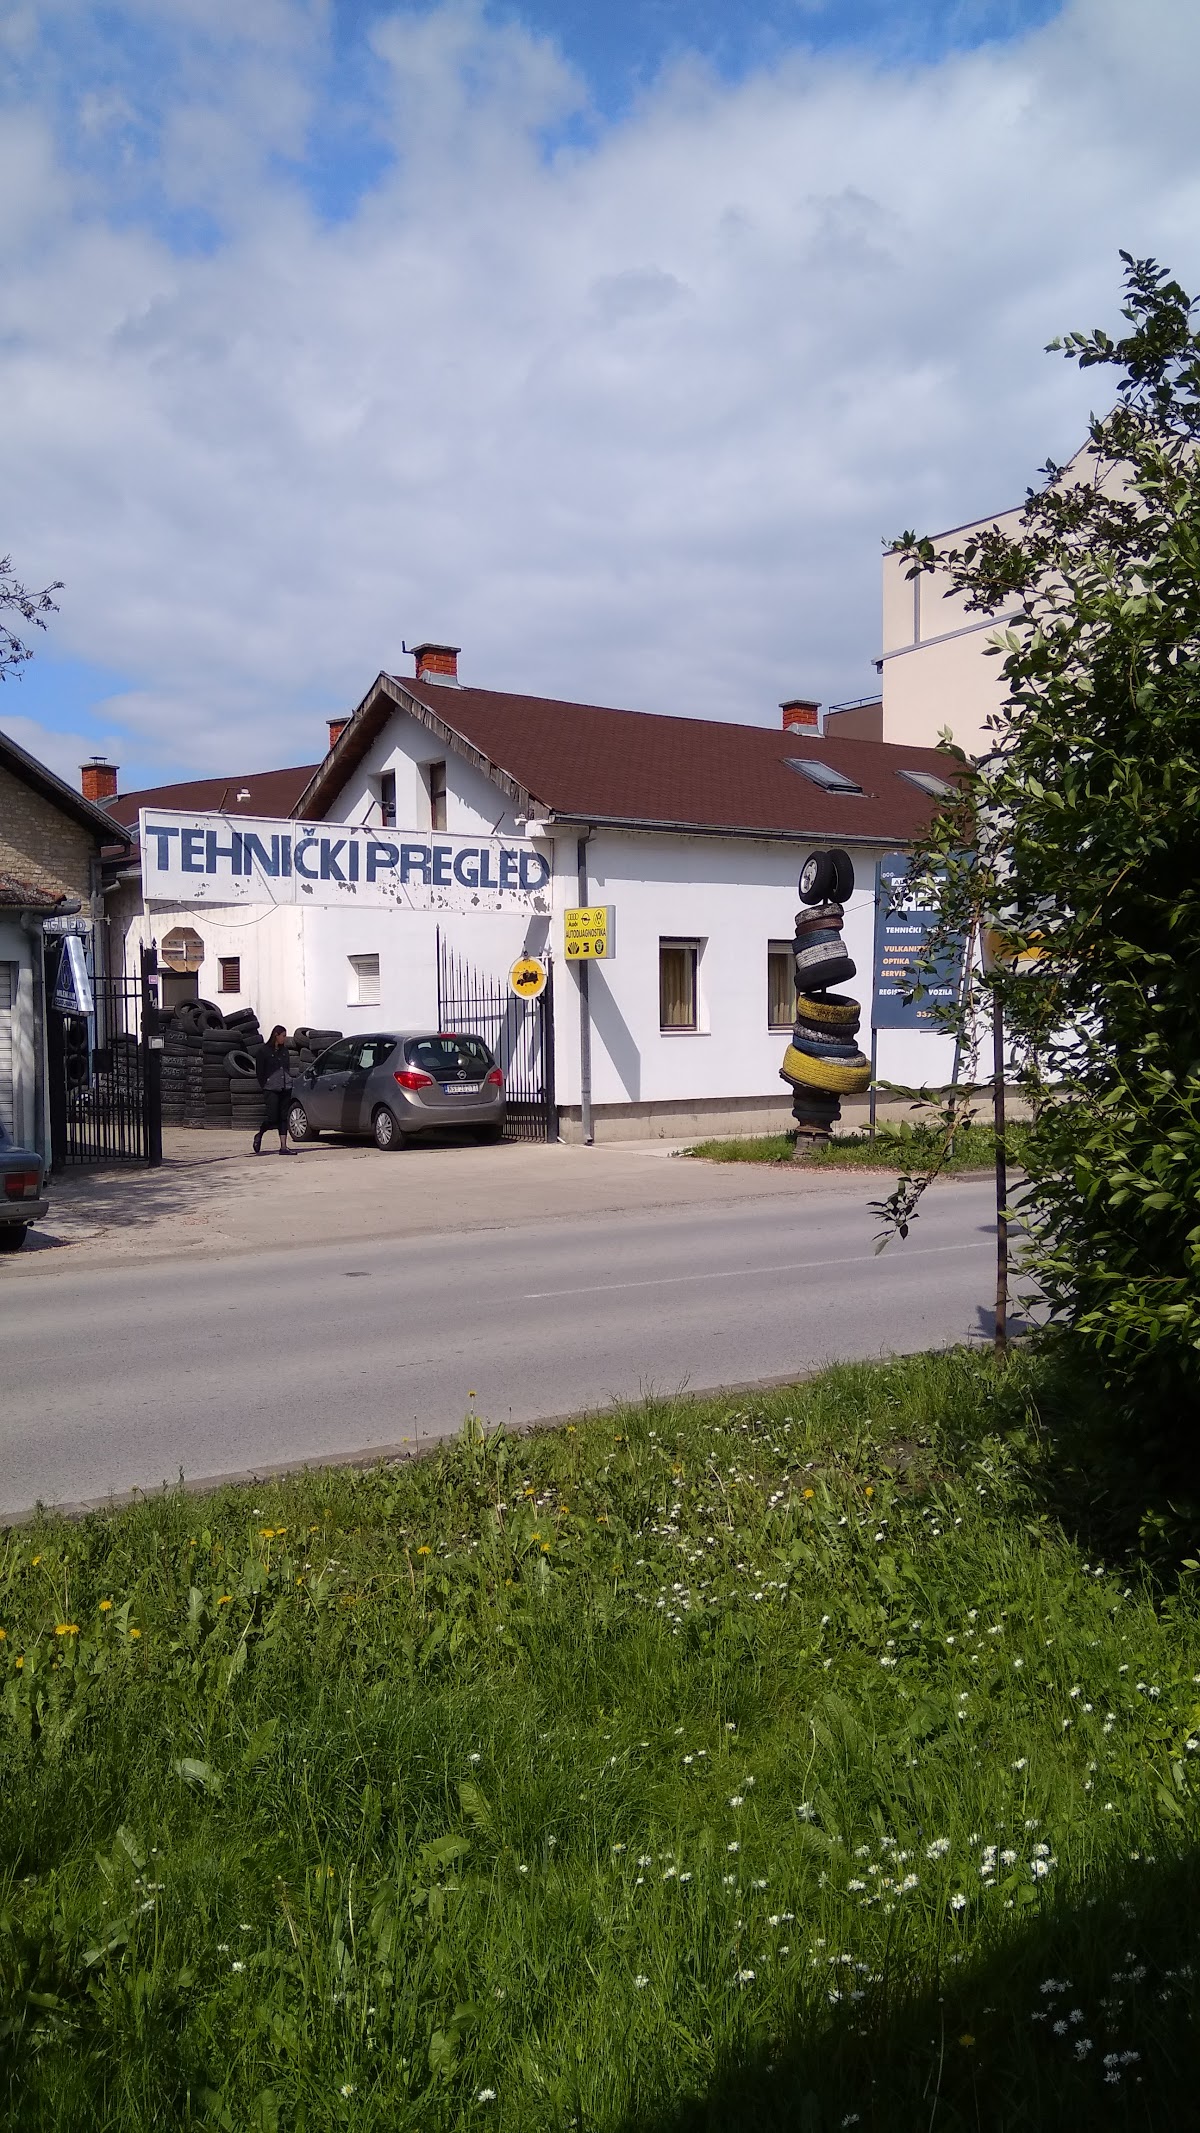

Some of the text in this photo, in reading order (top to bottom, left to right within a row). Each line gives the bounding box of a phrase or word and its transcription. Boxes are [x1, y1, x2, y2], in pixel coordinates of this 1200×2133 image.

[146, 825, 551, 890] TEHNIČKI PREGLED
[886, 925, 922, 934] TEHNIČKI
[928, 988, 953, 996] VOZILA
